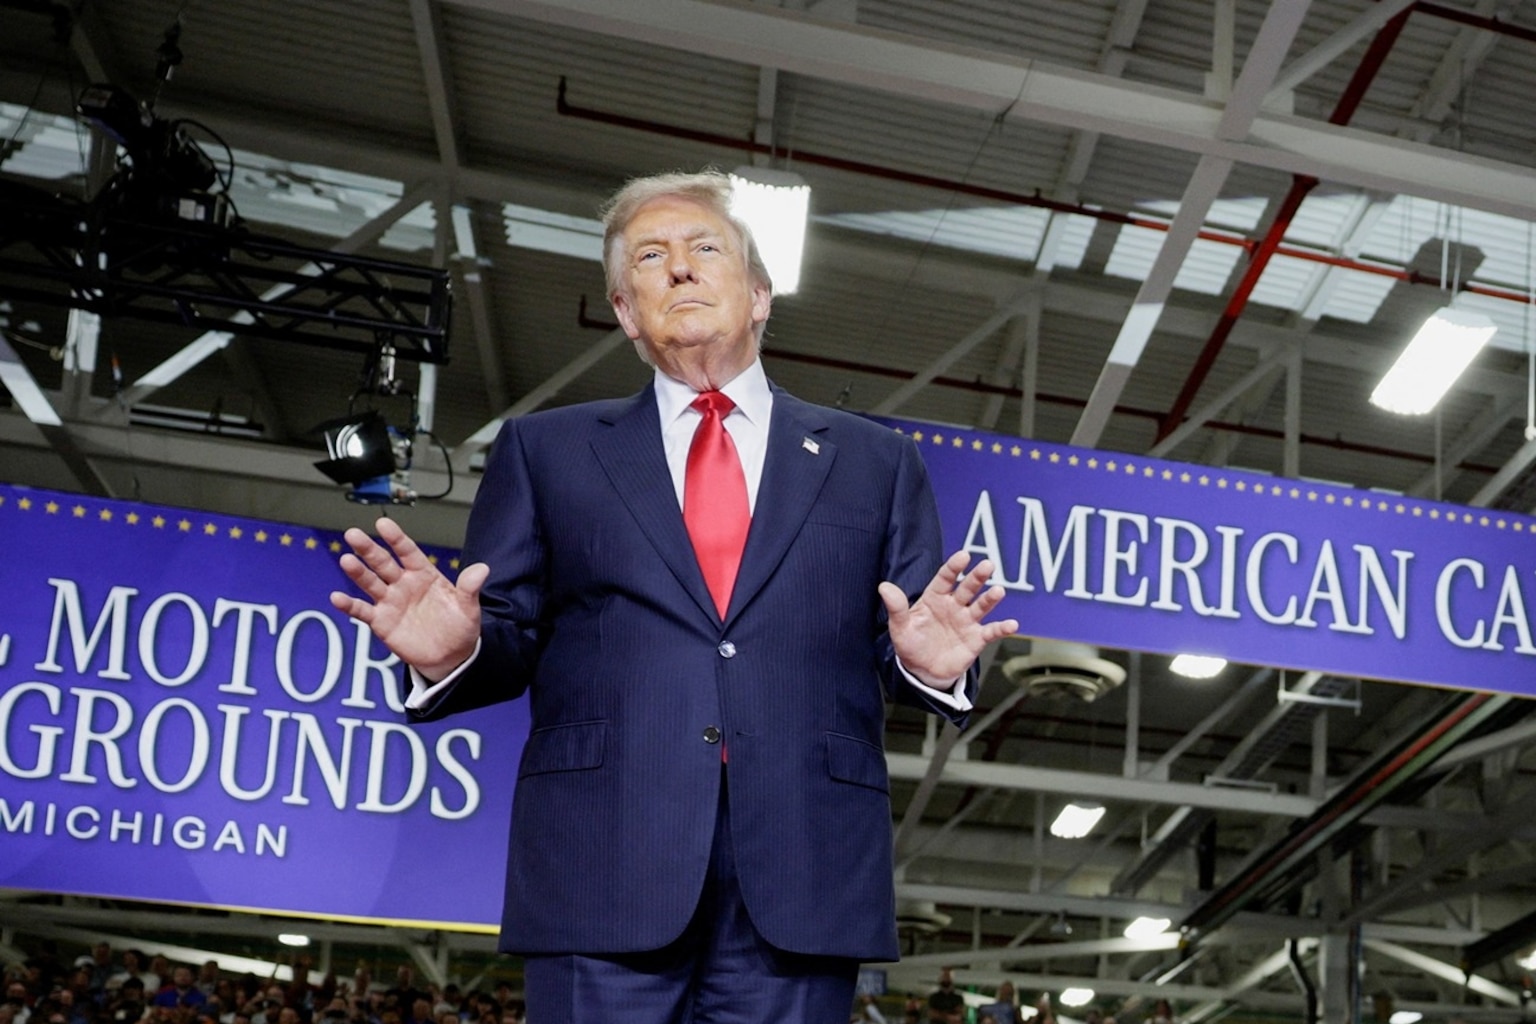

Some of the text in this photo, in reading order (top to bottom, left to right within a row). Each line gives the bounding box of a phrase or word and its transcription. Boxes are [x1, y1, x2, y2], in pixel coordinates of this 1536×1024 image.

[956, 490, 1414, 640] AMERICAN
[34, 578, 406, 713] MOTOR
[0, 681, 481, 819] GROUNDS
[0, 798, 287, 858] MICHIGAN
